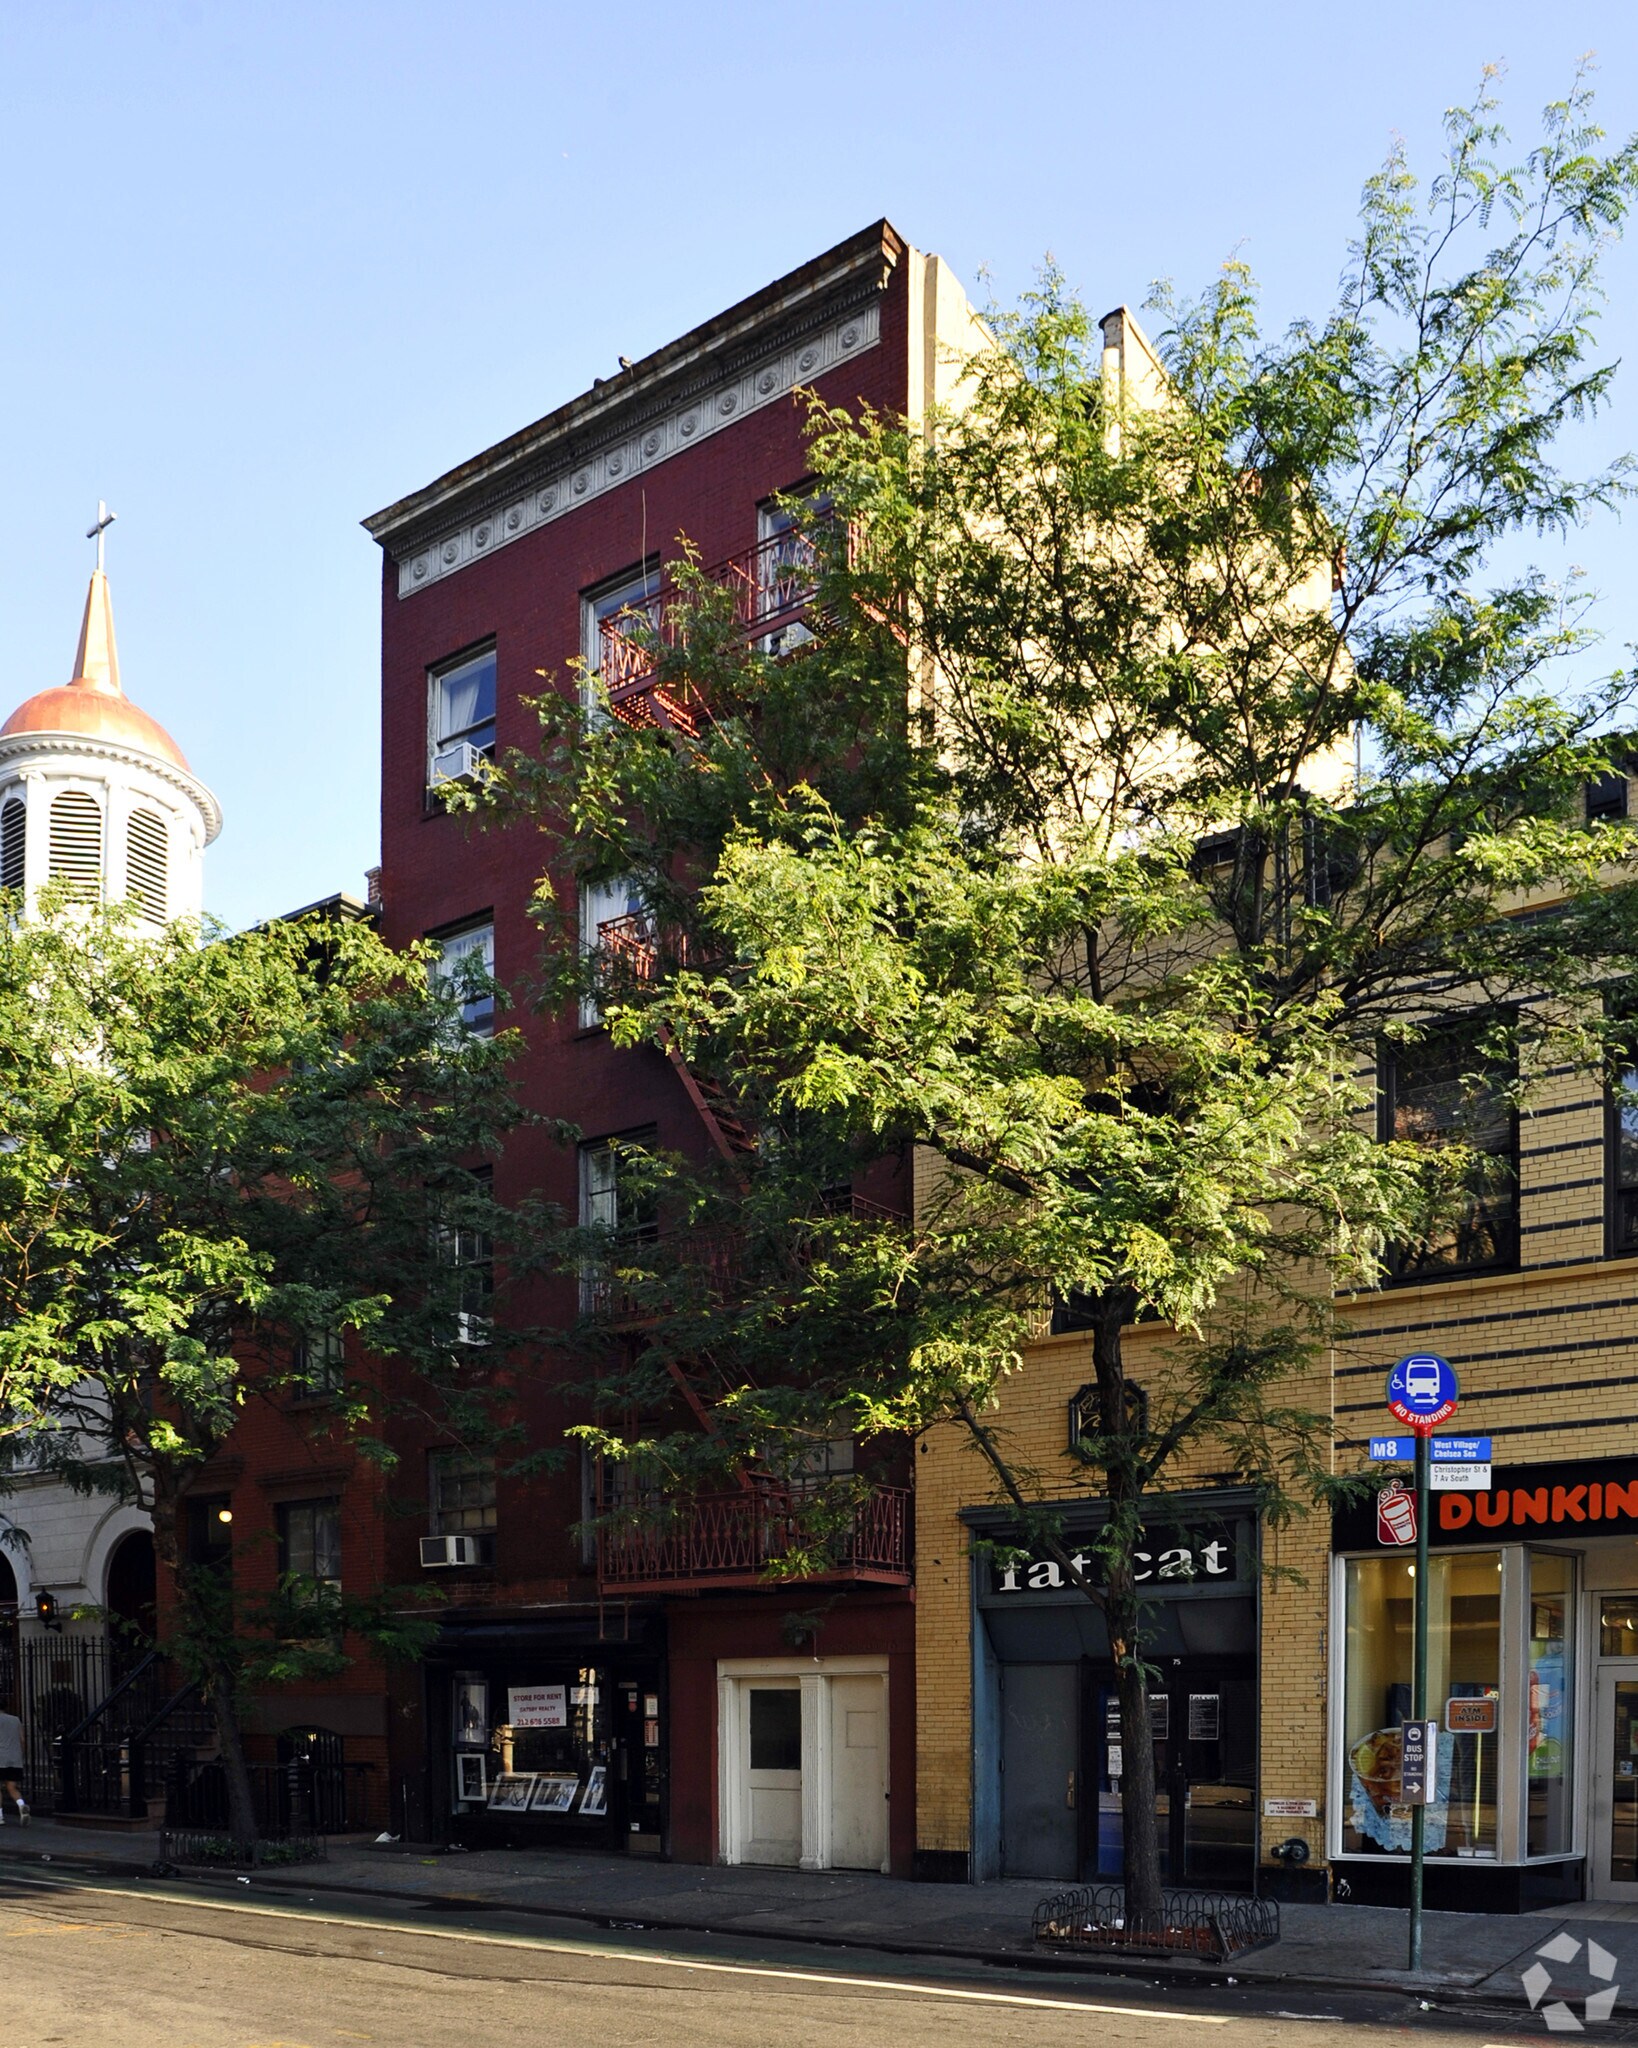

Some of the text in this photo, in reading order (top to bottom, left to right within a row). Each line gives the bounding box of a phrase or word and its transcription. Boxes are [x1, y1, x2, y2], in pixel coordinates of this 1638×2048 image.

[1394, 1403, 1452, 1424] NO STANDING
[1373, 1440, 1397, 1457] M8
[1434, 1441, 1452, 1449] West
[1434, 1449, 1462, 1458] Chelsea
[1434, 1465, 1488, 1474] Christopher St &
[1434, 1474, 1470, 1482] 7 Av South
[1439, 1480, 1638, 1531] DUNKIN
[1132, 1540, 1228, 1582] cat
[1172, 1658, 1182, 1666] 75
[513, 1694, 532, 1702] STORE
[516, 1718, 529, 1726] 212
[1406, 1744, 1422, 1753] BUS
[1404, 1754, 1424, 1762] STOP
